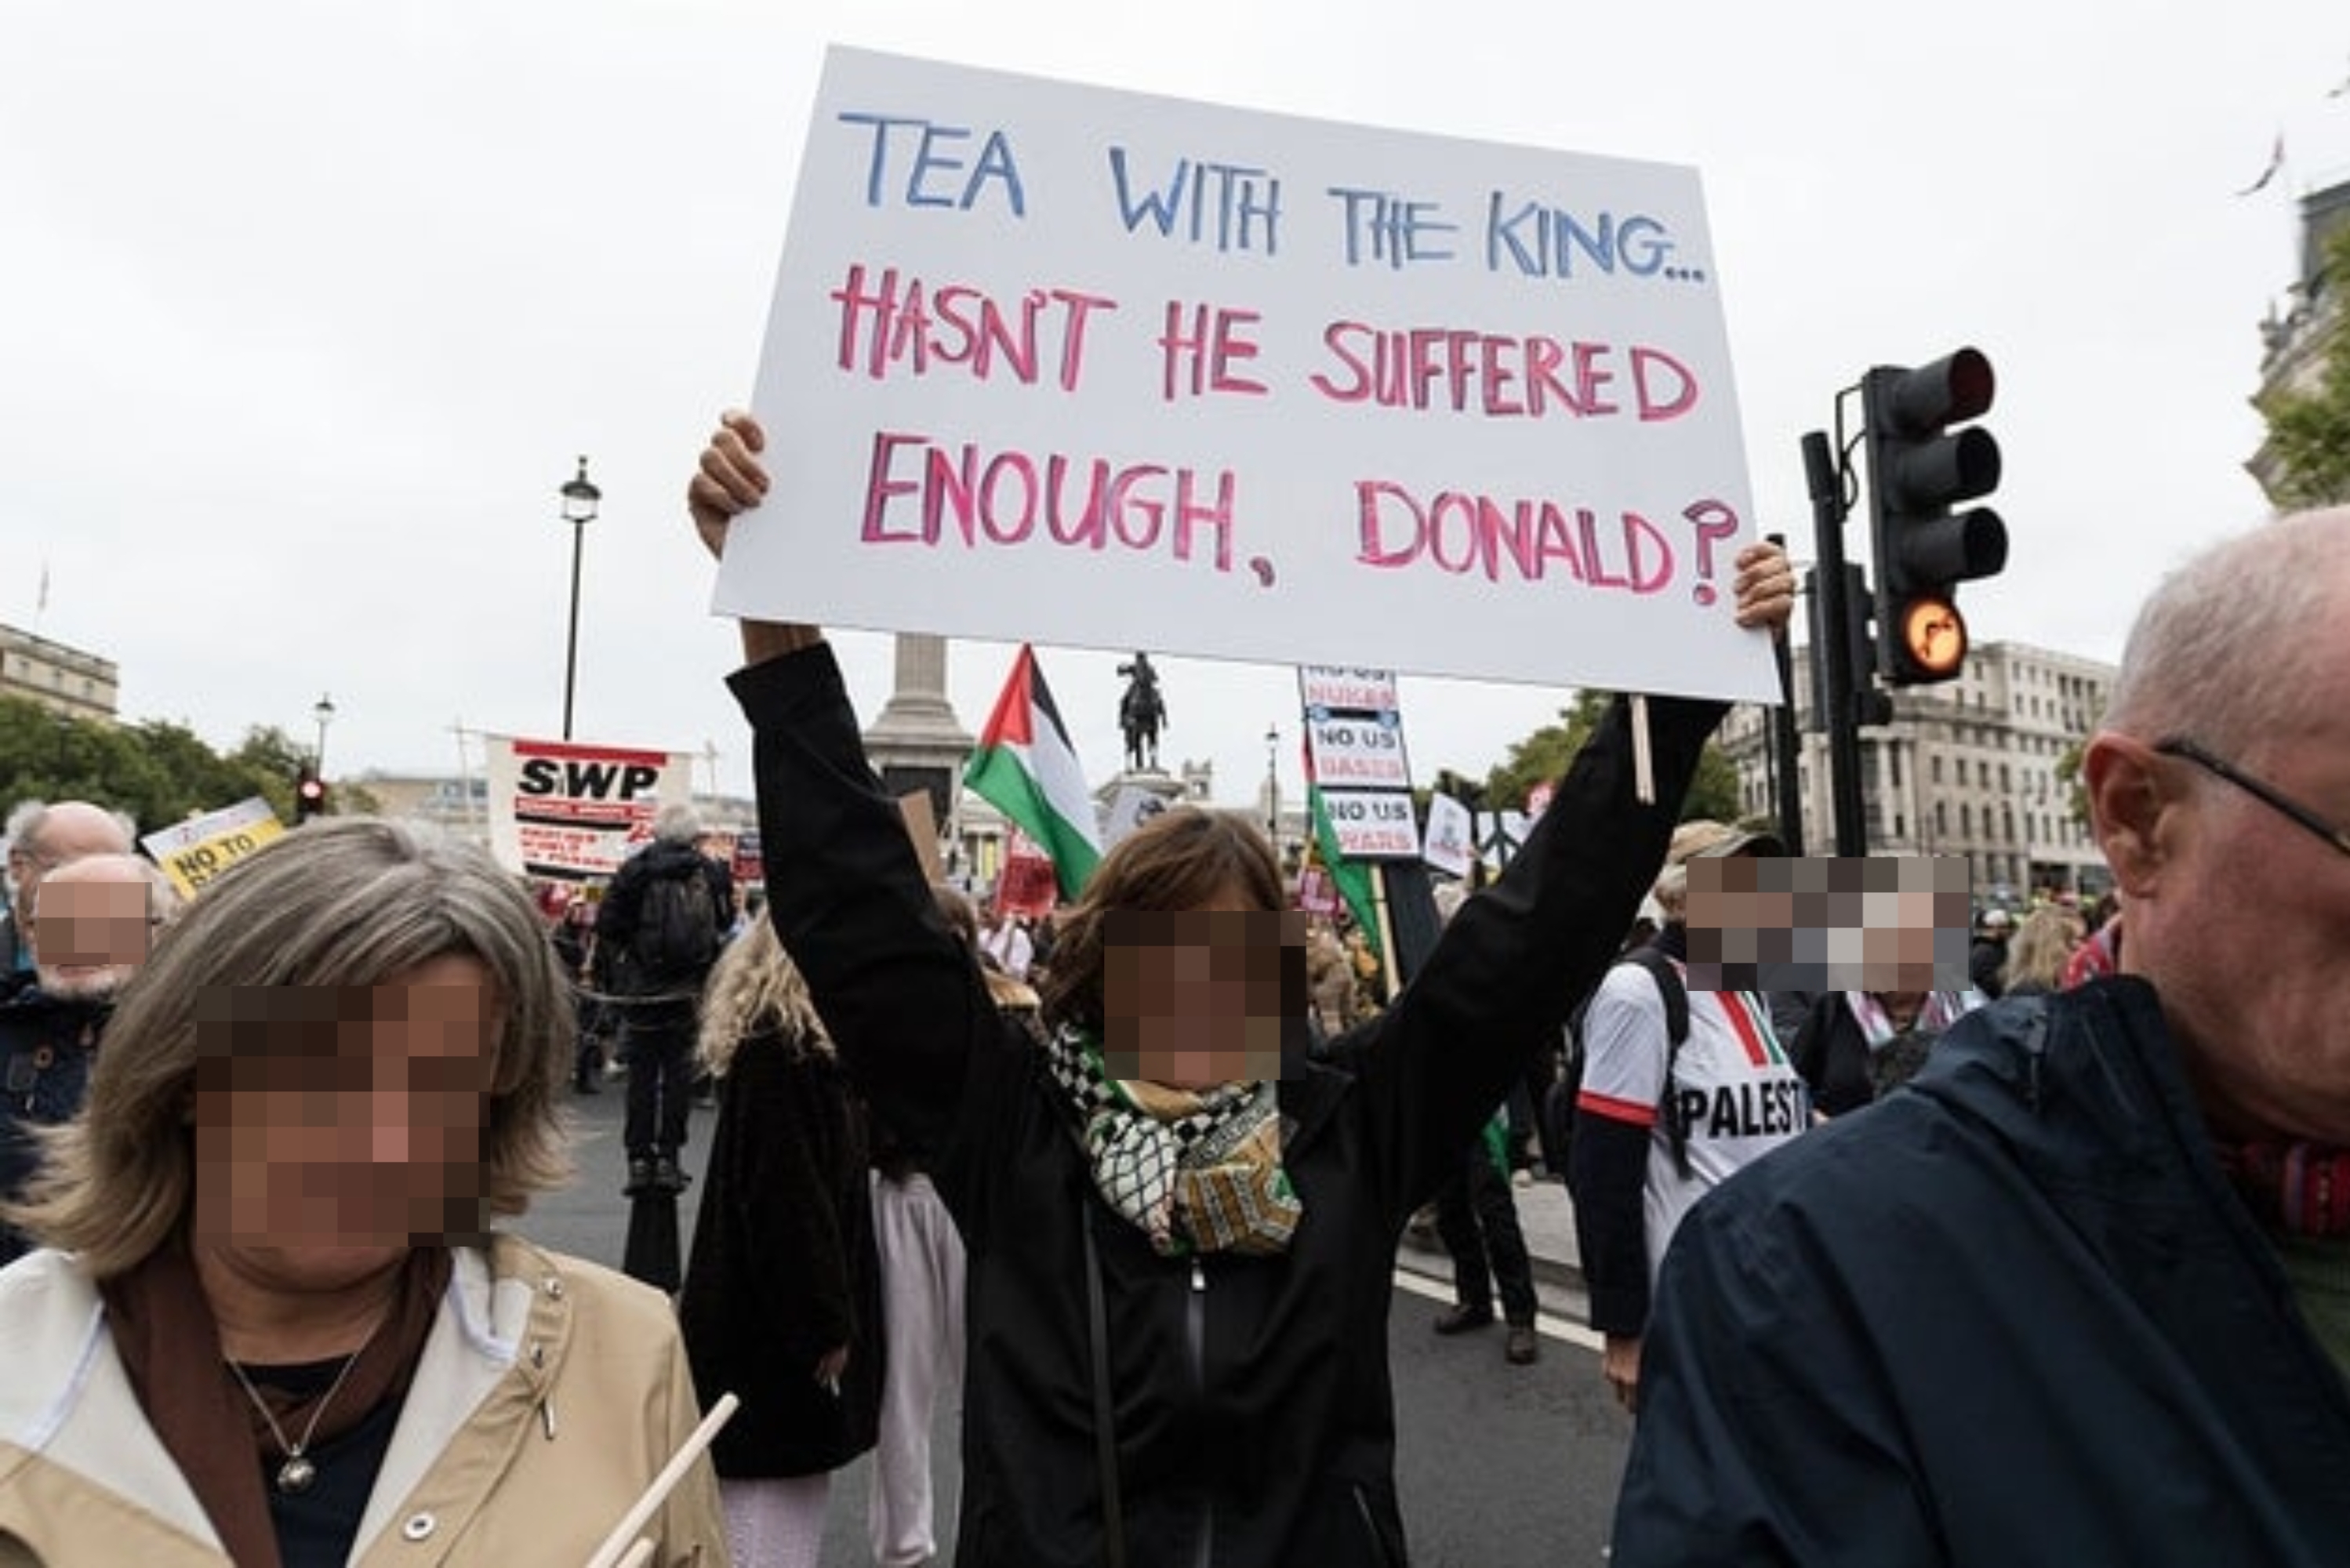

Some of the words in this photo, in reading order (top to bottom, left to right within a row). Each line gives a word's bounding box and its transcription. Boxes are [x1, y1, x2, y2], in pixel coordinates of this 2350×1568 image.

[838, 112, 1025, 218] TEA
[1109, 145, 1282, 256] WITH
[1328, 187, 1458, 270] THE
[1487, 191, 1705, 283] KING...
[830, 264, 1117, 392] HASN'T
[1159, 300, 1269, 401] HE
[1309, 321, 1700, 423] SUFFERED
[860, 431, 1275, 586] ENOUGH,
[1354, 480, 1738, 605] DONALD?
[1317, 728, 1354, 746] NO
[1361, 730, 1396, 749] US
[518, 758, 659, 800] SWP
[1327, 800, 1365, 820] NO
[1373, 801, 1407, 821] US
[173, 847, 217, 877] NO
[217, 833, 255, 855] TO
